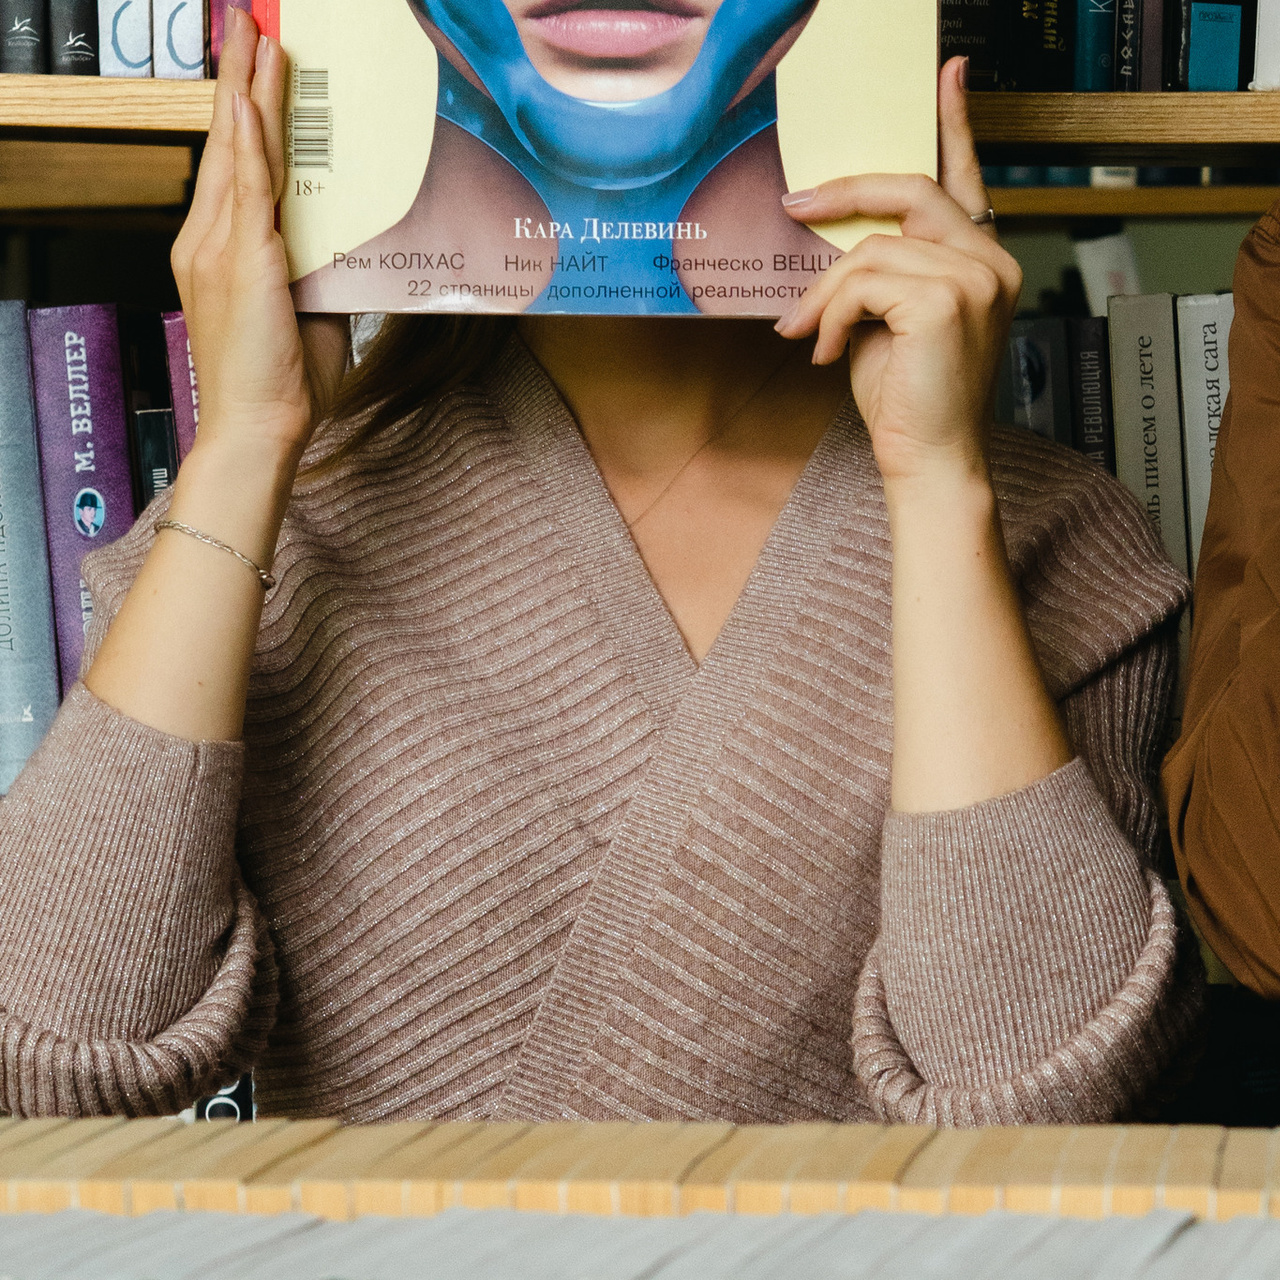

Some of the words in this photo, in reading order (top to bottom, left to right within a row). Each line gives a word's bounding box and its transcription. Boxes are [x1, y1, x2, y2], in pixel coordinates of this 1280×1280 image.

[295, 179, 325, 196] 18+
[333, 252, 371, 269] Рем
[379, 252, 465, 270] КОЛХАС
[504, 254, 543, 271] Ник
[551, 251, 609, 272] НАЙТ
[653, 253, 764, 272] Франческо
[407, 280, 432, 297] 22
[439, 284, 534, 301] страницы
[547, 282, 681, 301] дополненной
[692, 284, 808, 301] реальности
[1201, 321, 1220, 372] сага
[1137, 334, 1155, 391] лете
[64, 330, 93, 437] ВЕЛЛЕР
[1141, 395, 1156, 410] о
[75, 441, 97, 473] М.
[1142, 413, 1160, 490] писем
